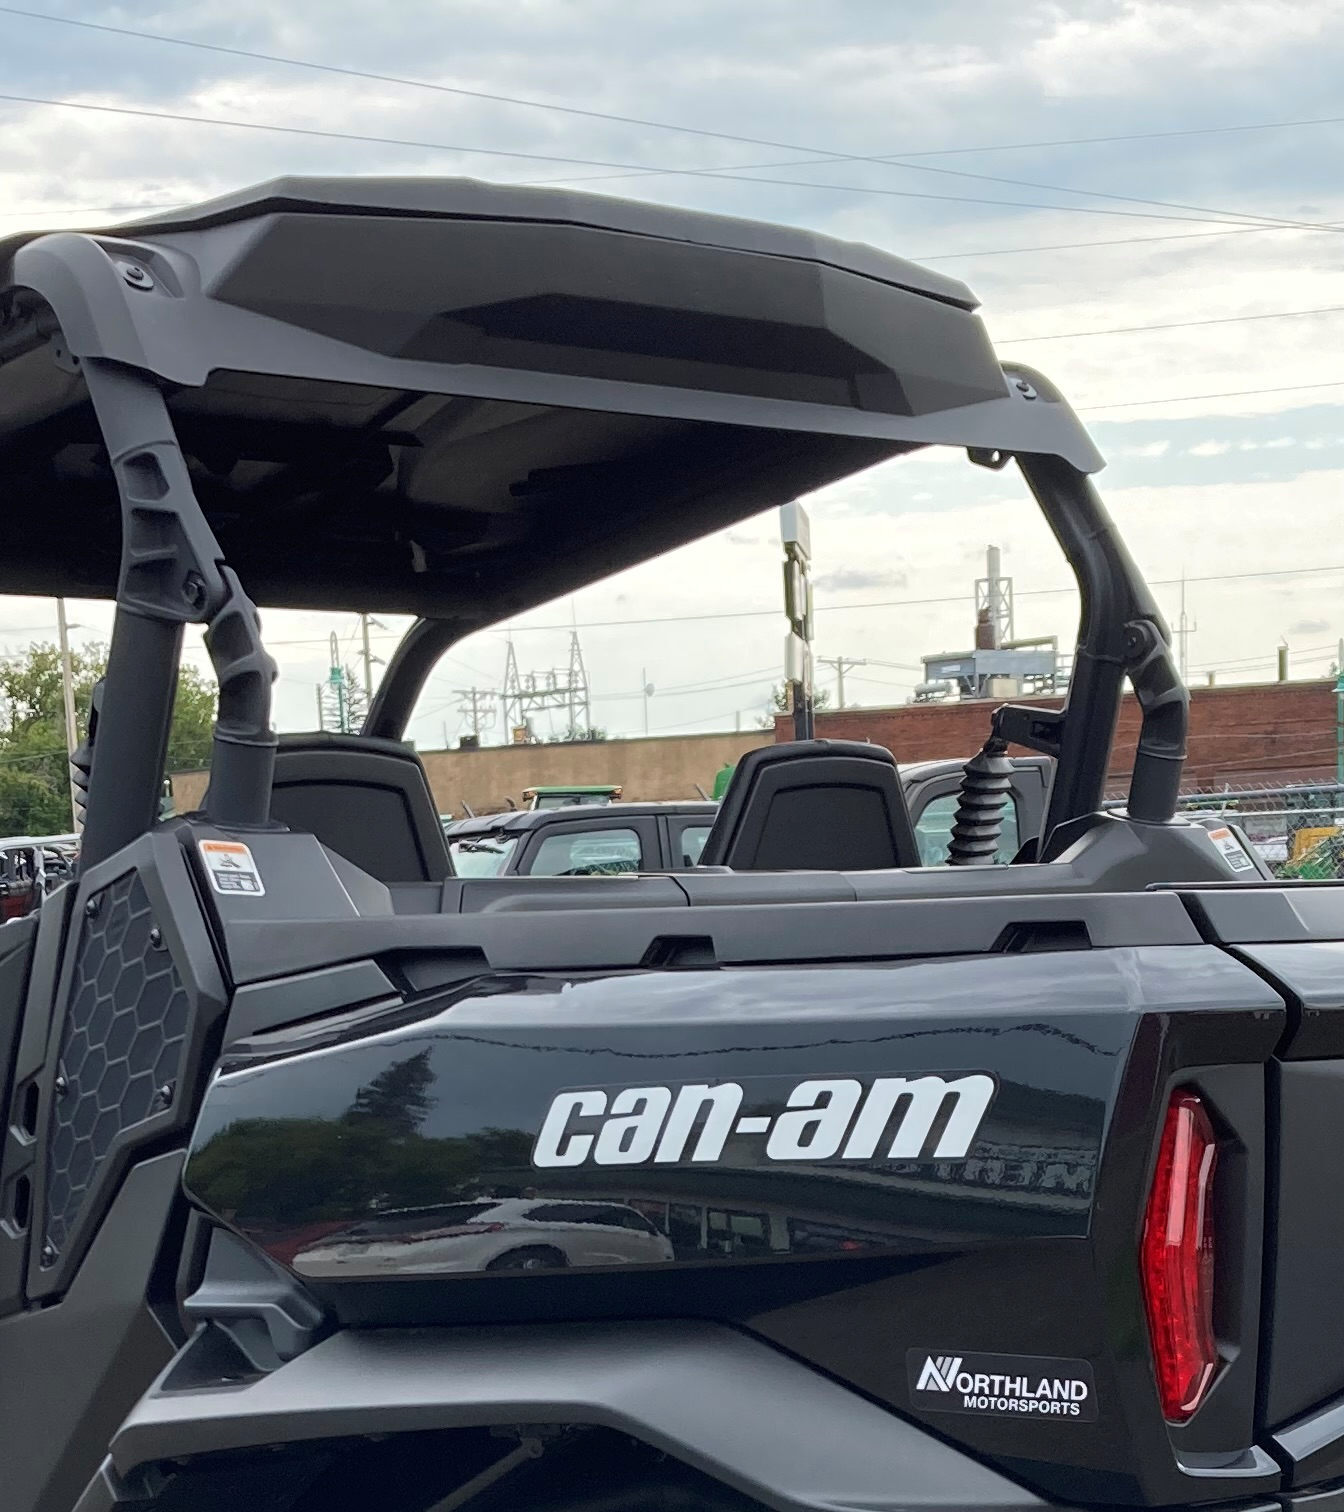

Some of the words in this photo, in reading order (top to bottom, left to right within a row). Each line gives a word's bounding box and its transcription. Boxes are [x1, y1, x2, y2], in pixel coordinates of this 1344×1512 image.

[533, 1075, 995, 1168] can-am
[916, 1355, 1089, 1401] NORTHLAND
[963, 1395, 1081, 1416] MOTORSPORTS
